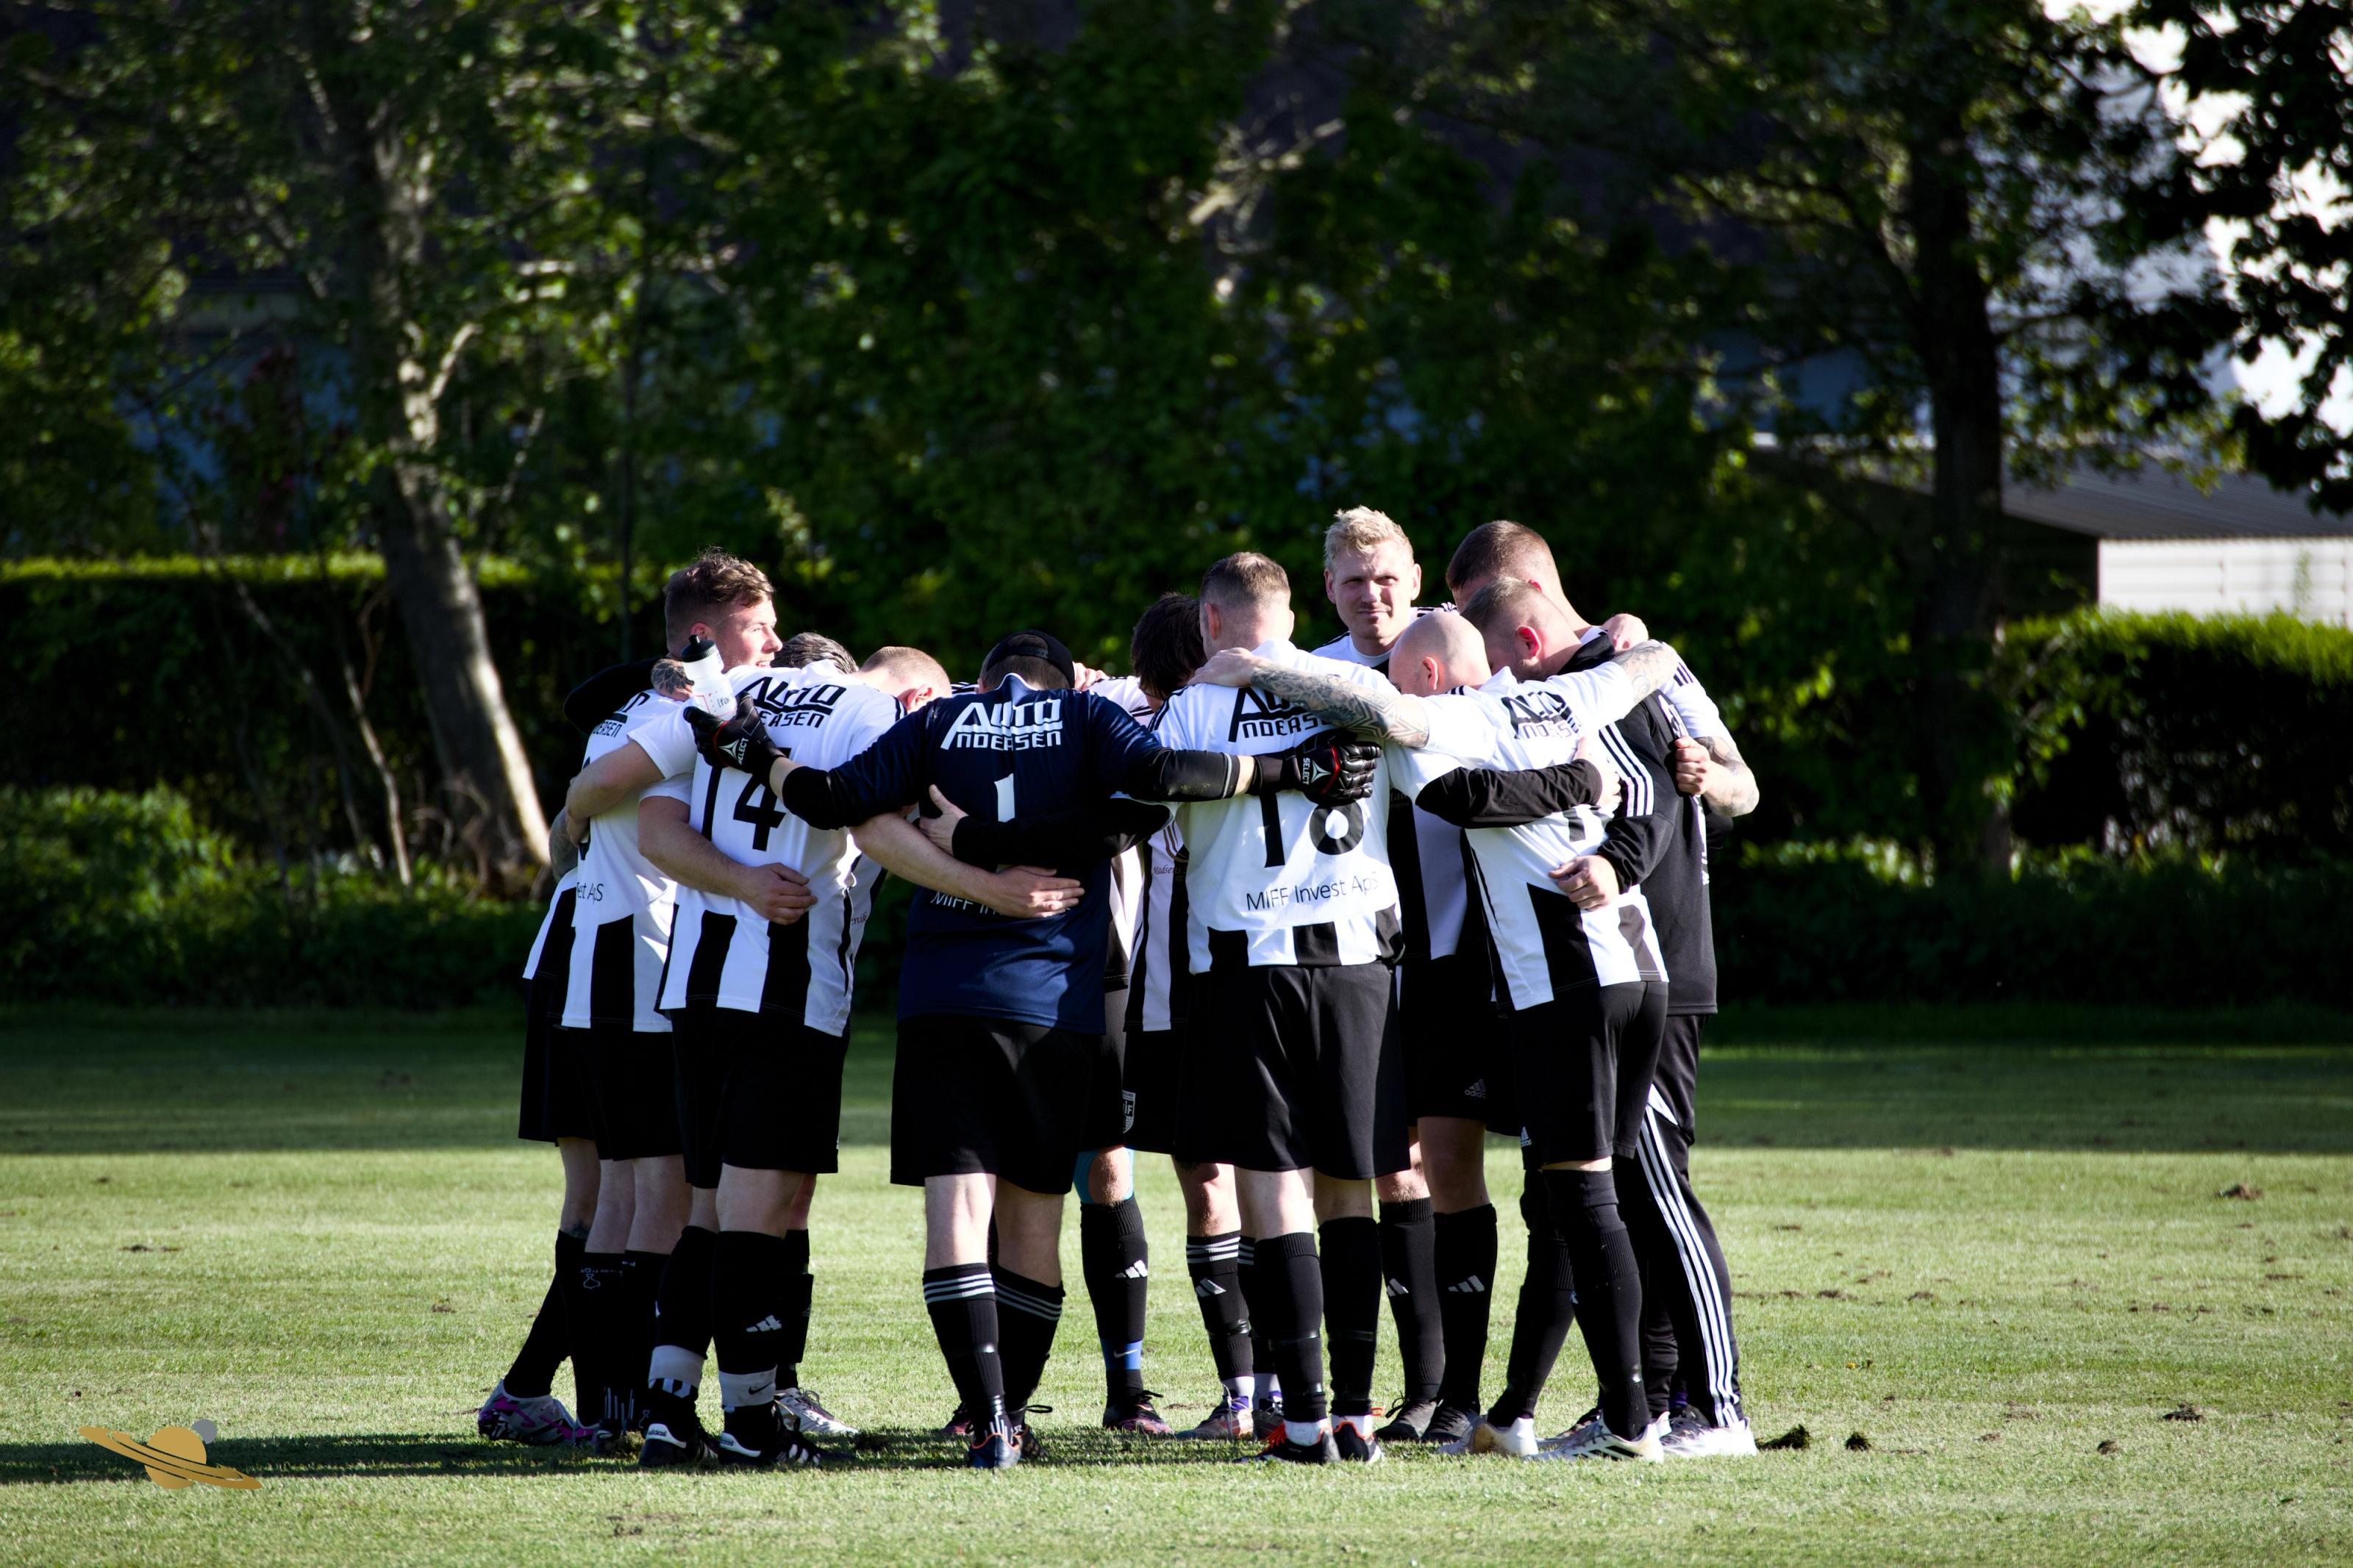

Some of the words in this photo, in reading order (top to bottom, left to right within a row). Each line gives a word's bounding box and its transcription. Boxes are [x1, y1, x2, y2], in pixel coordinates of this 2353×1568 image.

[759, 712, 824, 728] ERSEN
[940, 699, 1063, 750] AUTO
[1242, 712, 1328, 738] NDERS
[1302, 757, 1310, 785] SELECT
[1246, 887, 1288, 911] MIFF
[1295, 879, 1347, 903] Invest
